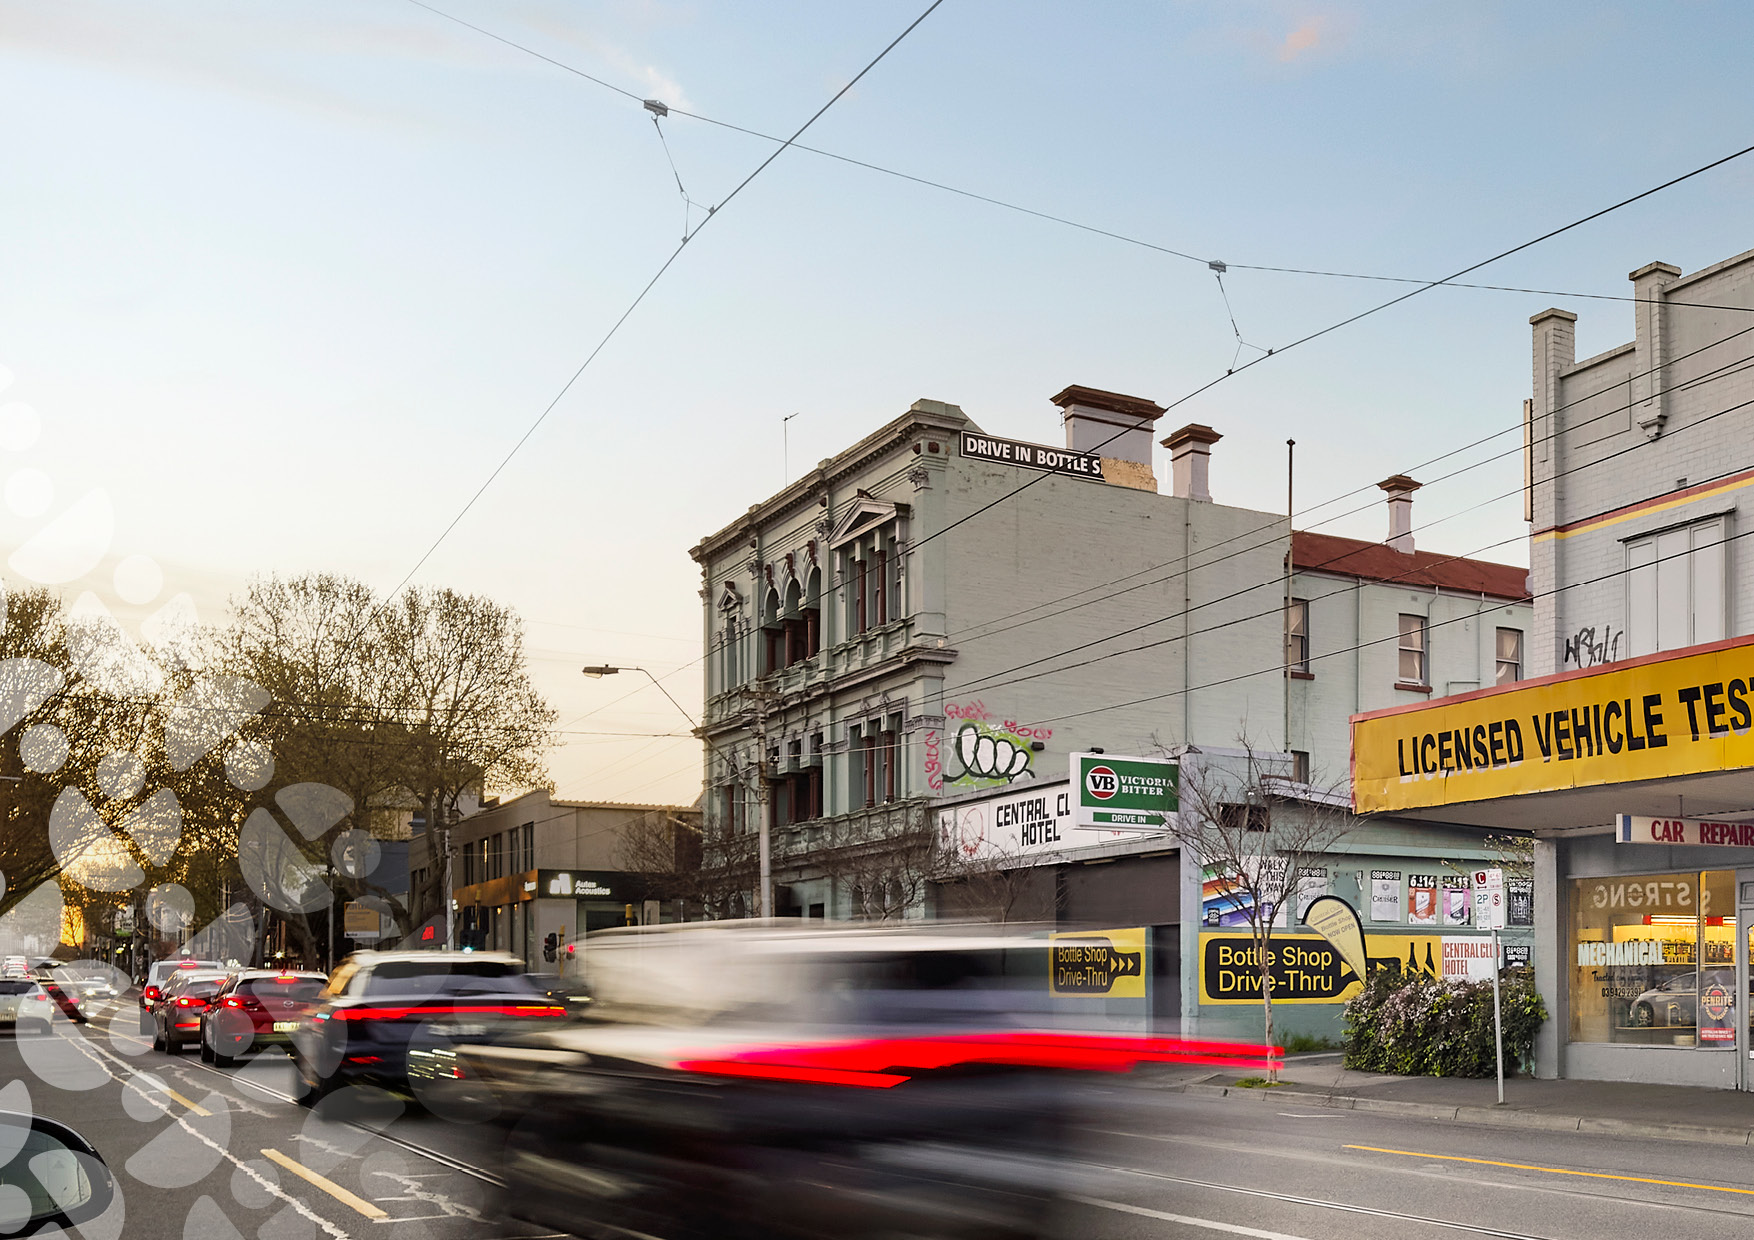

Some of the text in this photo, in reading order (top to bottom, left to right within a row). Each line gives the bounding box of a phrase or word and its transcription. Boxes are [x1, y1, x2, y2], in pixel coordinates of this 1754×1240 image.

[966, 437, 1010, 459] DRIVE
[1015, 446, 1031, 463] IN
[1037, 449, 1088, 472] BOTTLE
[1398, 718, 1524, 780] LICENSED
[1533, 694, 1668, 763] VEHICLE
[1090, 774, 1115, 791] VB
[1120, 775, 1173, 787] VICTORIA
[1121, 785, 1164, 796] BITTER
[996, 797, 1050, 828] CENTRAL
[1111, 814, 1146, 824] DRIVE IN
[1021, 819, 1061, 847] HOTEL
[1651, 820, 1685, 842] CAR
[575, 887, 611, 895] Acoustics
[1477, 894, 1489, 904] 2P
[1327, 922, 1356, 938] NOW OPEN
[1058, 945, 1107, 966] Bottle Shop
[1219, 946, 1332, 971] Bottle Shop
[1444, 942, 1480, 958] CENTRAL
[1578, 941, 1665, 967] MECHANICAL
[1058, 966, 1108, 987] Drive-Thru
[1444, 959, 1469, 975] HOTEL
[1219, 970, 1333, 992] Drive-Thru
[1701, 995, 1733, 1006] PENRITE
